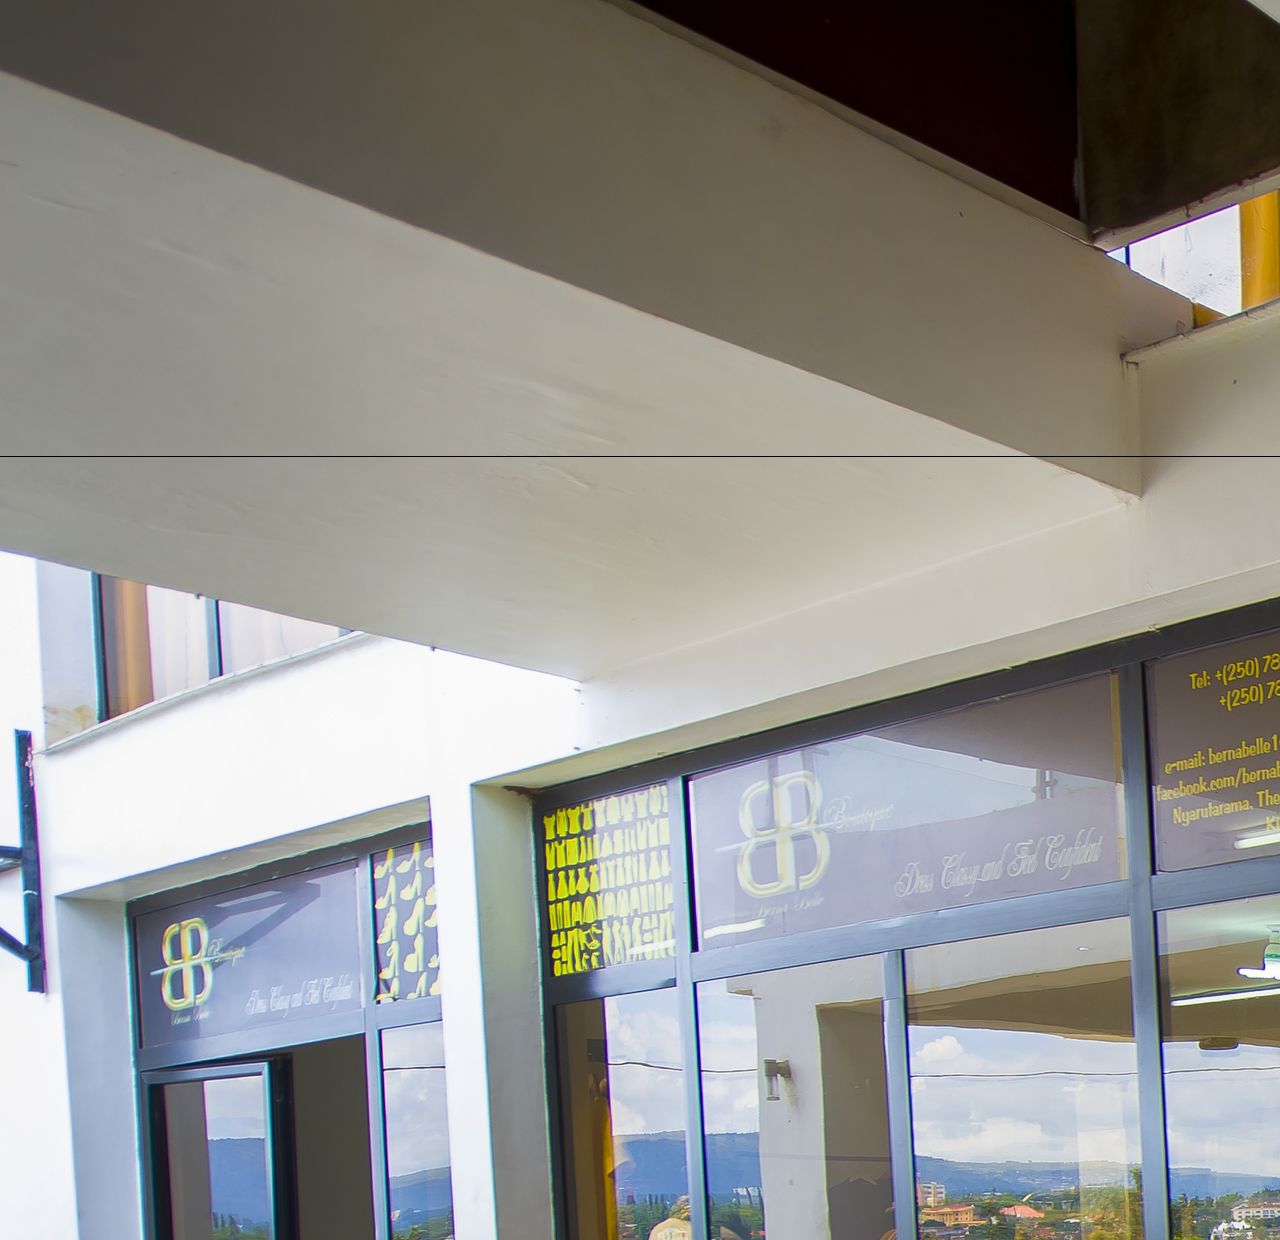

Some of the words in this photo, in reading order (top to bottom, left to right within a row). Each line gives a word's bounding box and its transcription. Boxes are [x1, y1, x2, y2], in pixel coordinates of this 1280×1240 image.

[1189, 671, 1211, 689] Tel:
[1216, 657, 1260, 686] +(250)
[1219, 683, 1264, 712] +(250)
[1164, 751, 1207, 775] e-mail:
[1256, 789, 1280, 808] The
